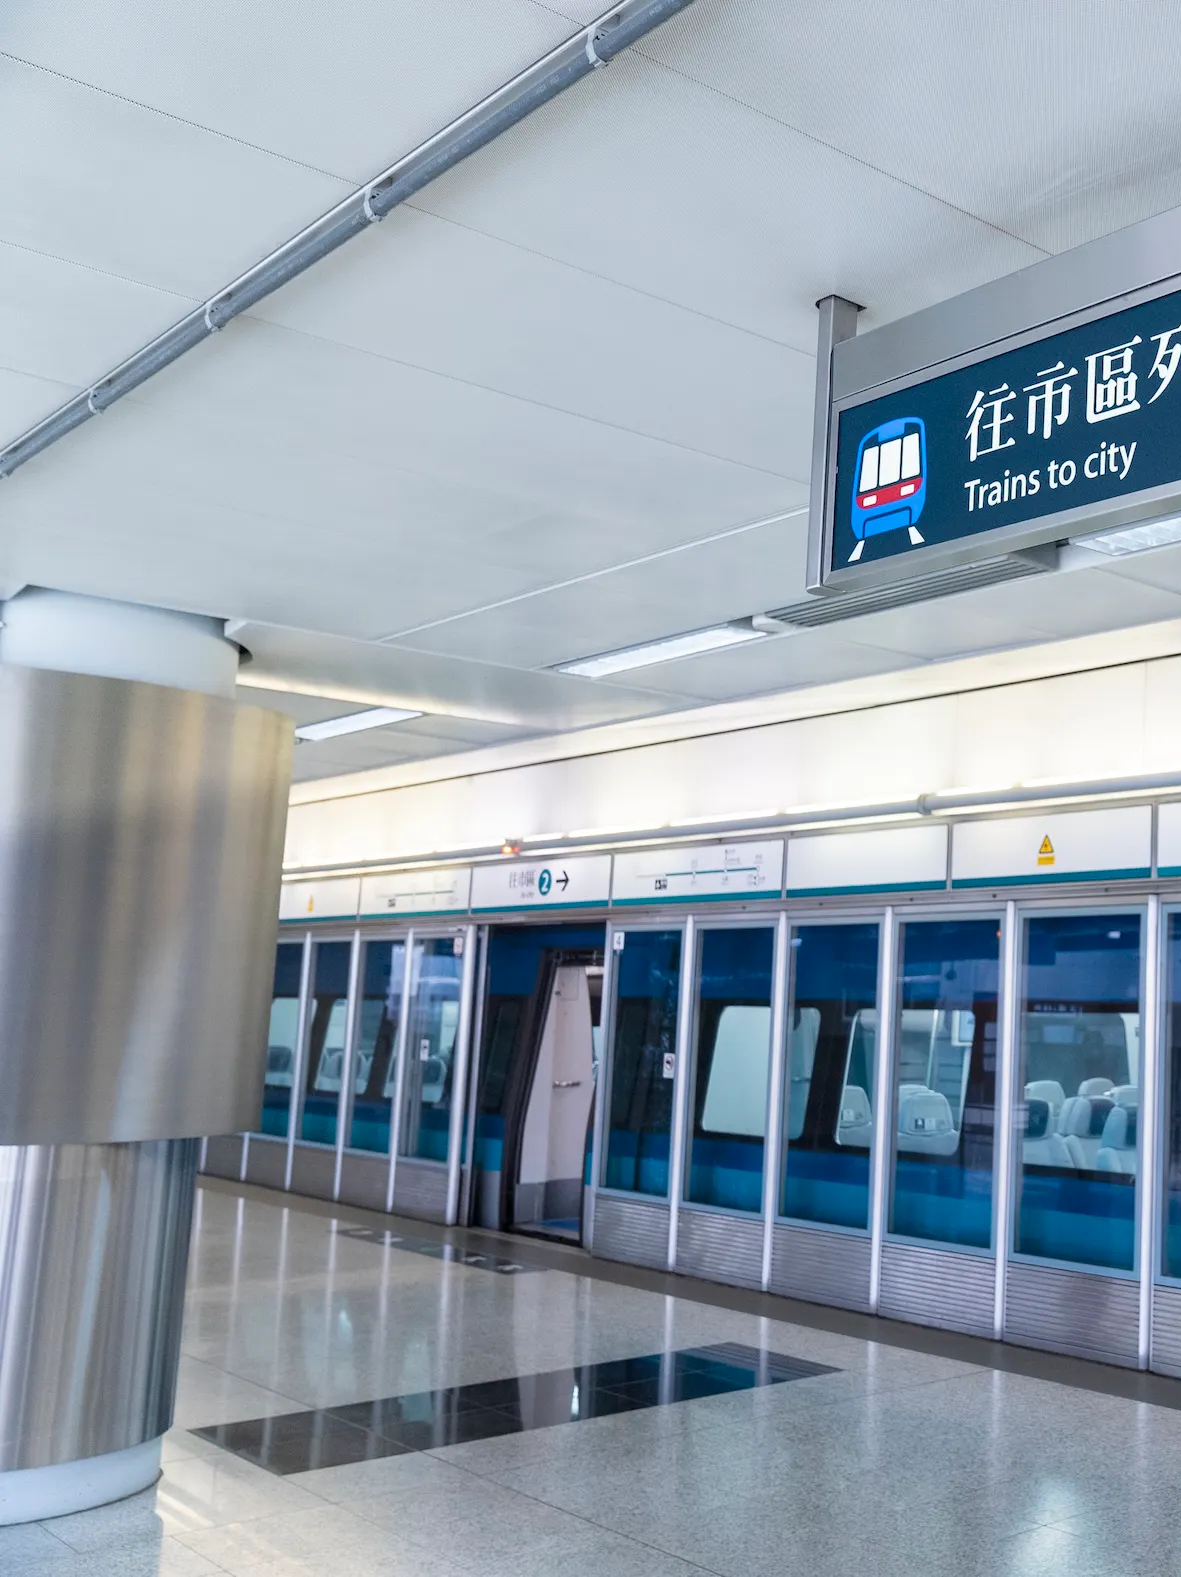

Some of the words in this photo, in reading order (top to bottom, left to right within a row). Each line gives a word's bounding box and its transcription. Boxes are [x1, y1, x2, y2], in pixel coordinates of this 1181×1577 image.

[964, 469, 1041, 513] Trains
[1046, 457, 1077, 488] to
[1083, 440, 1138, 480] city
[541, 872, 550, 893] 2
